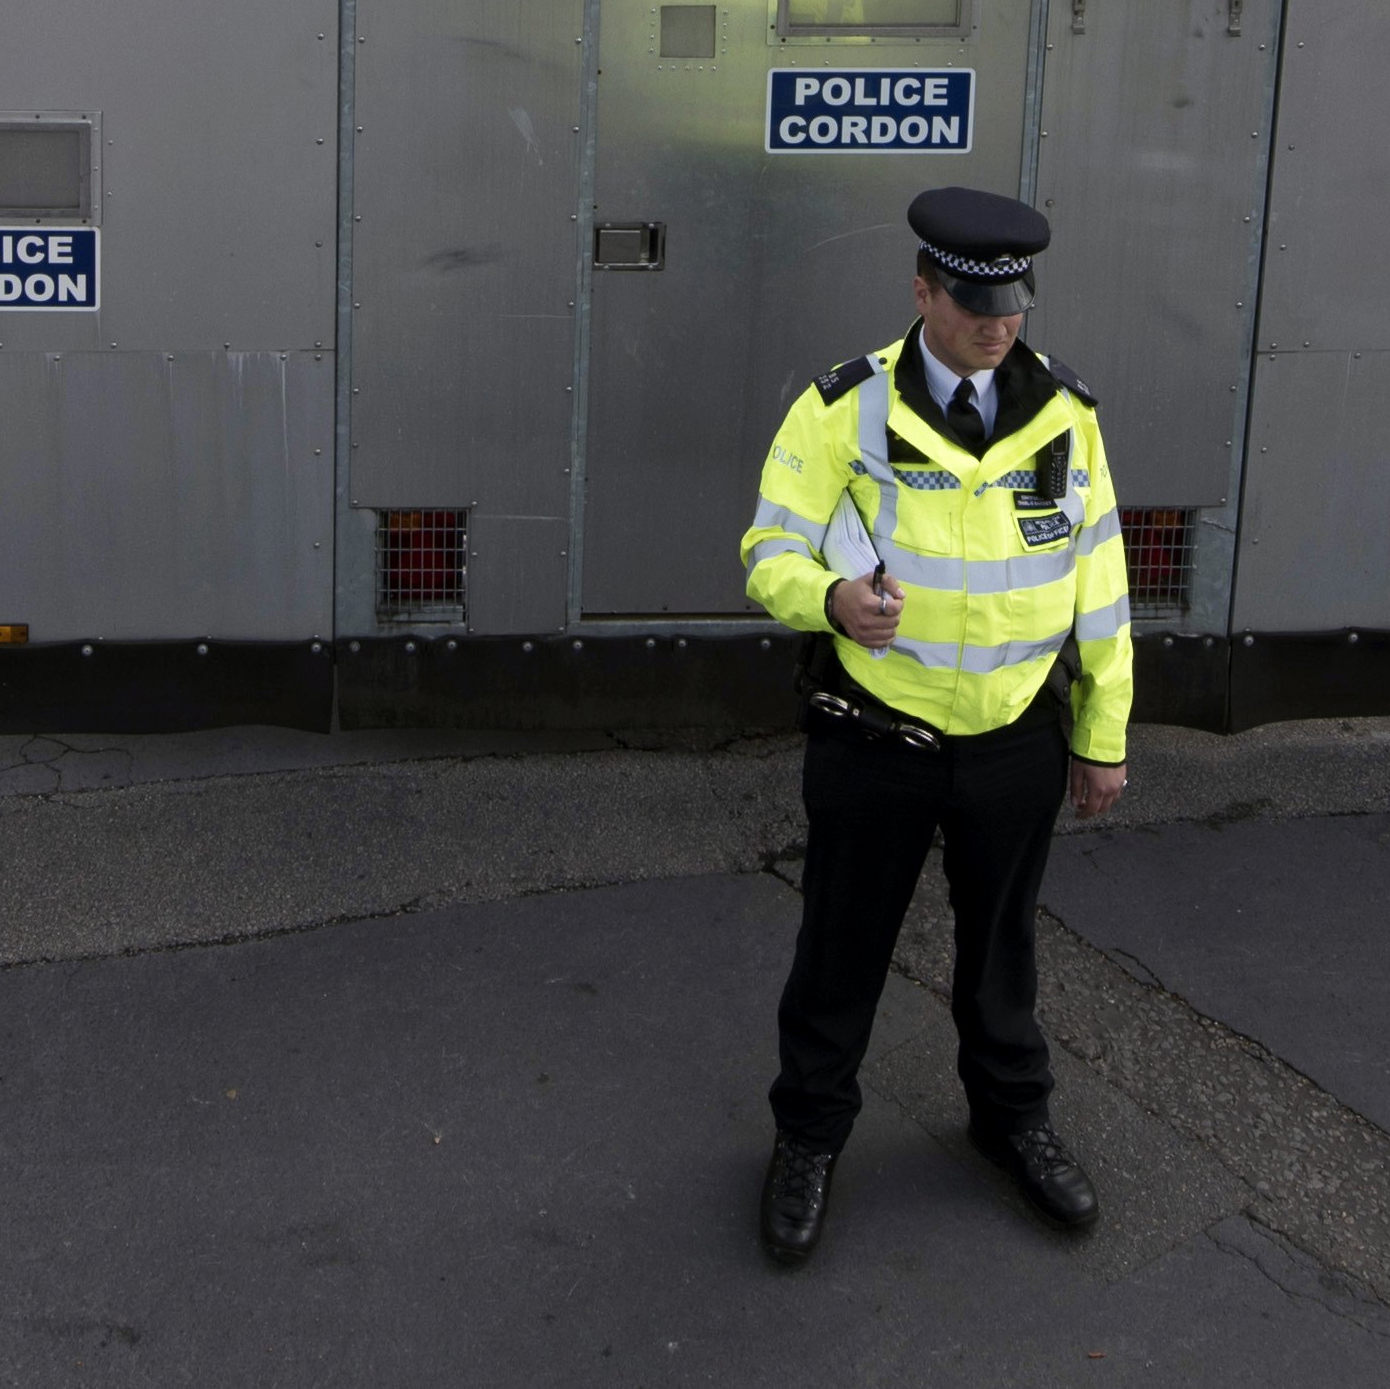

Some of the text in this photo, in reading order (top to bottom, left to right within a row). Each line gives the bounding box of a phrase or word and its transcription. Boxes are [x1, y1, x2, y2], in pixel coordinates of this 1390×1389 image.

[796, 78, 948, 105] POLICE
[780, 116, 959, 143] CORDON
[772, 445, 805, 474] OLICE
